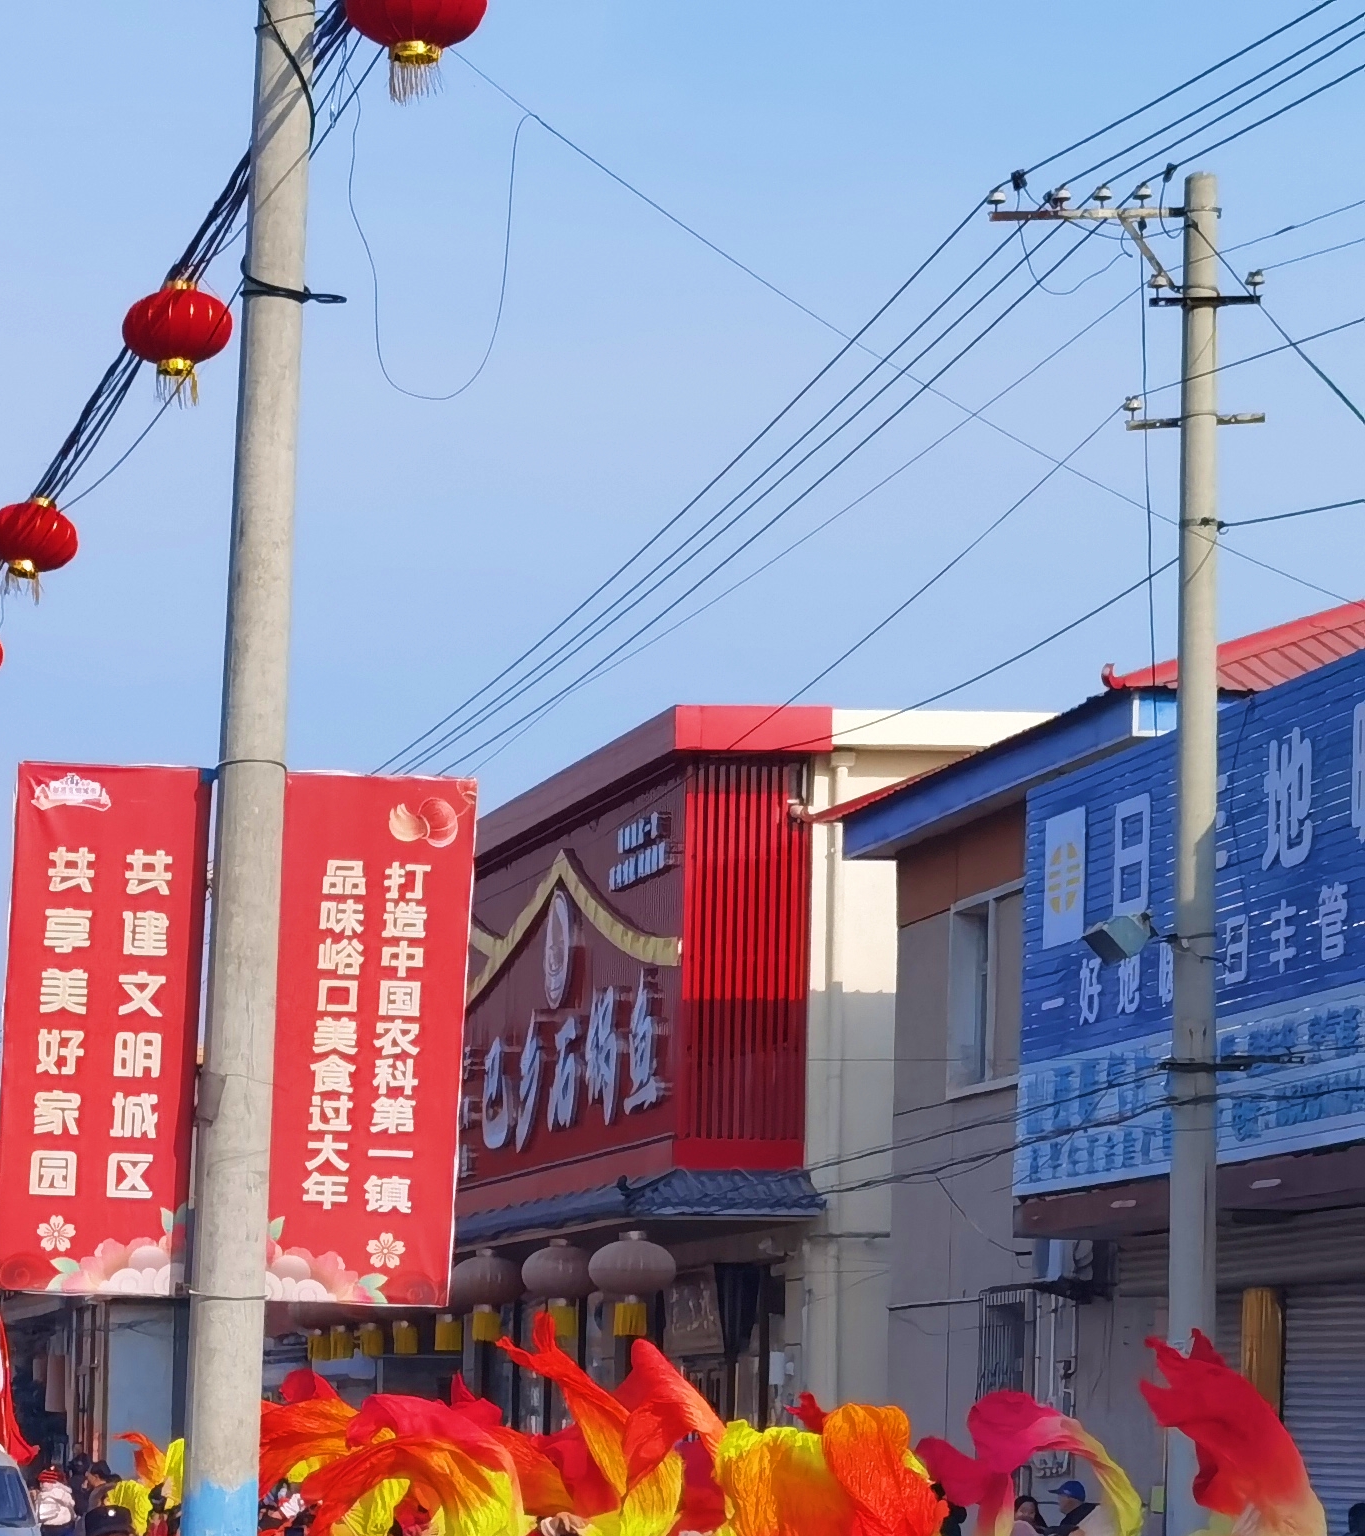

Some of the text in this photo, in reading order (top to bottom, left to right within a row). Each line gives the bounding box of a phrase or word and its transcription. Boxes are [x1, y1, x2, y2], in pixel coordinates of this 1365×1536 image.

[29, 846, 96, 1197] 共享美好家园
[106, 849, 173, 1199] 共建文明城区
[302, 859, 367, 1210] 品味峪口美食过大年
[364, 861, 431, 1215] 打造中国农科第一镇
